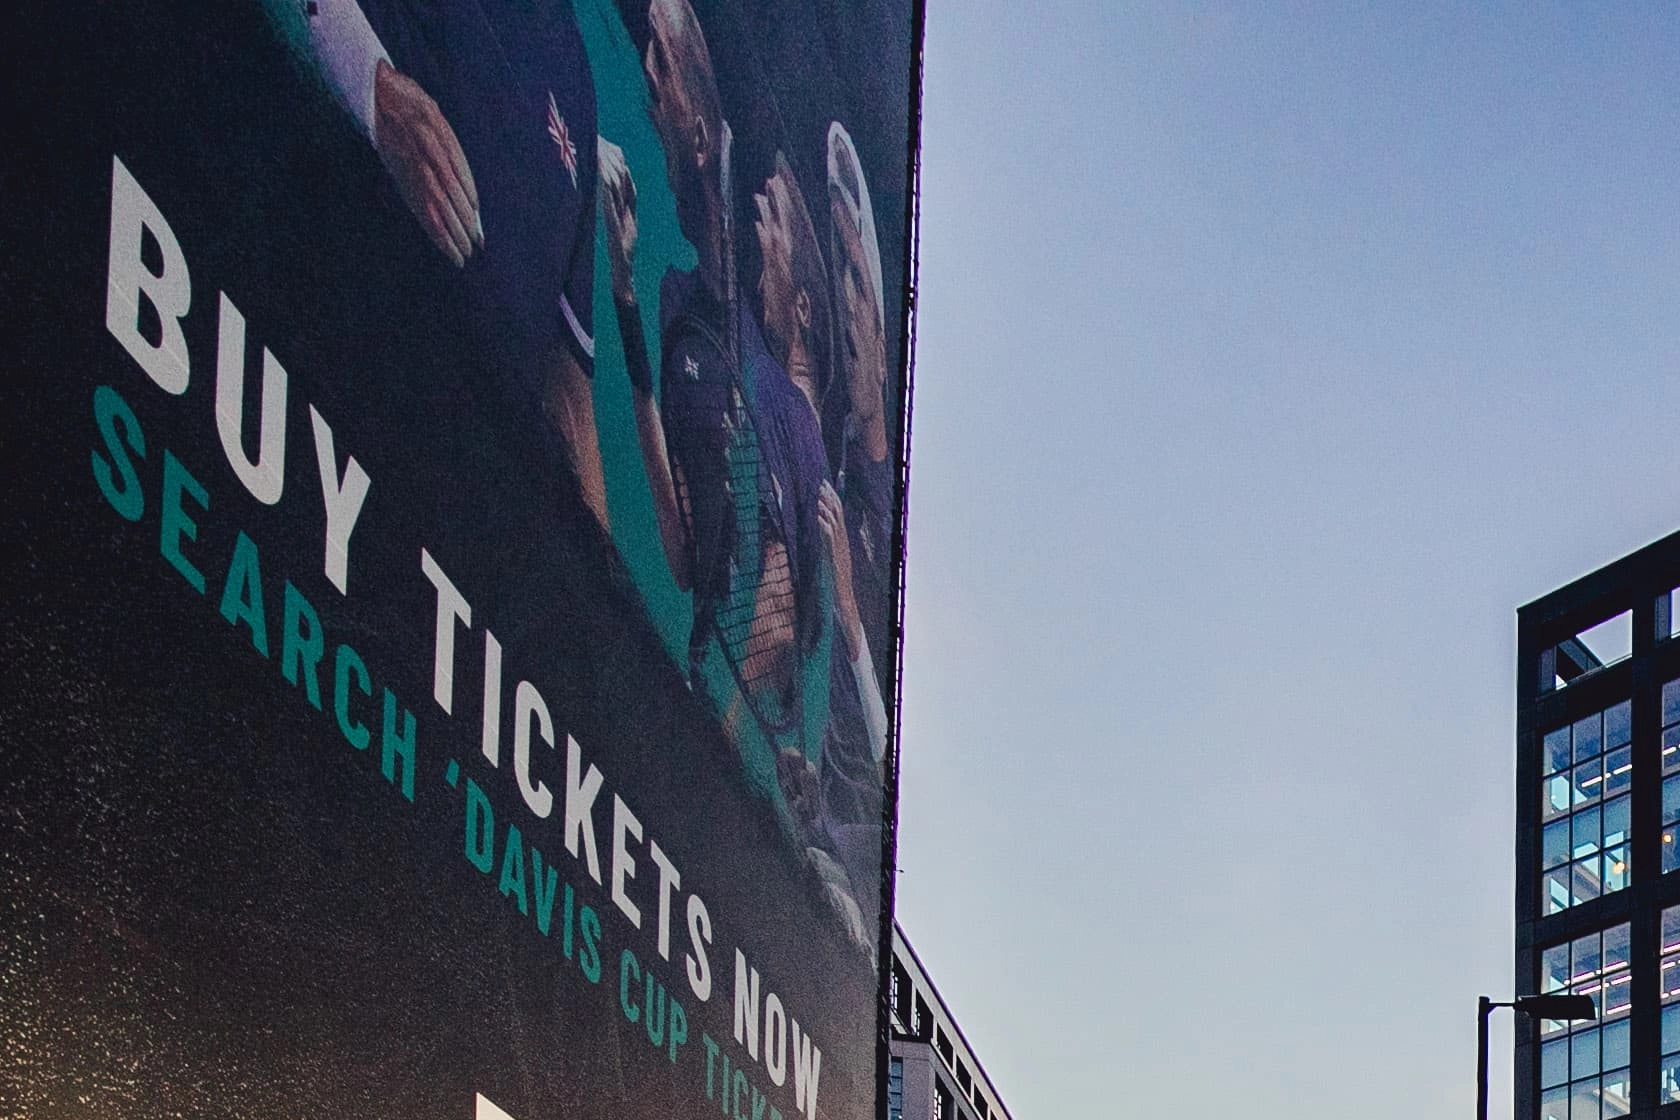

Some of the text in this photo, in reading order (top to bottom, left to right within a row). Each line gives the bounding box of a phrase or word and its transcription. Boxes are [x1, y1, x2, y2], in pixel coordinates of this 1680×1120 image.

[92, 384, 416, 804] SEARCH
[446, 757, 601, 985] 'DAVIS
[620, 949, 689, 1065] CUP
[106, 154, 372, 597] BUY
[421, 546, 712, 1002] TICKETS
